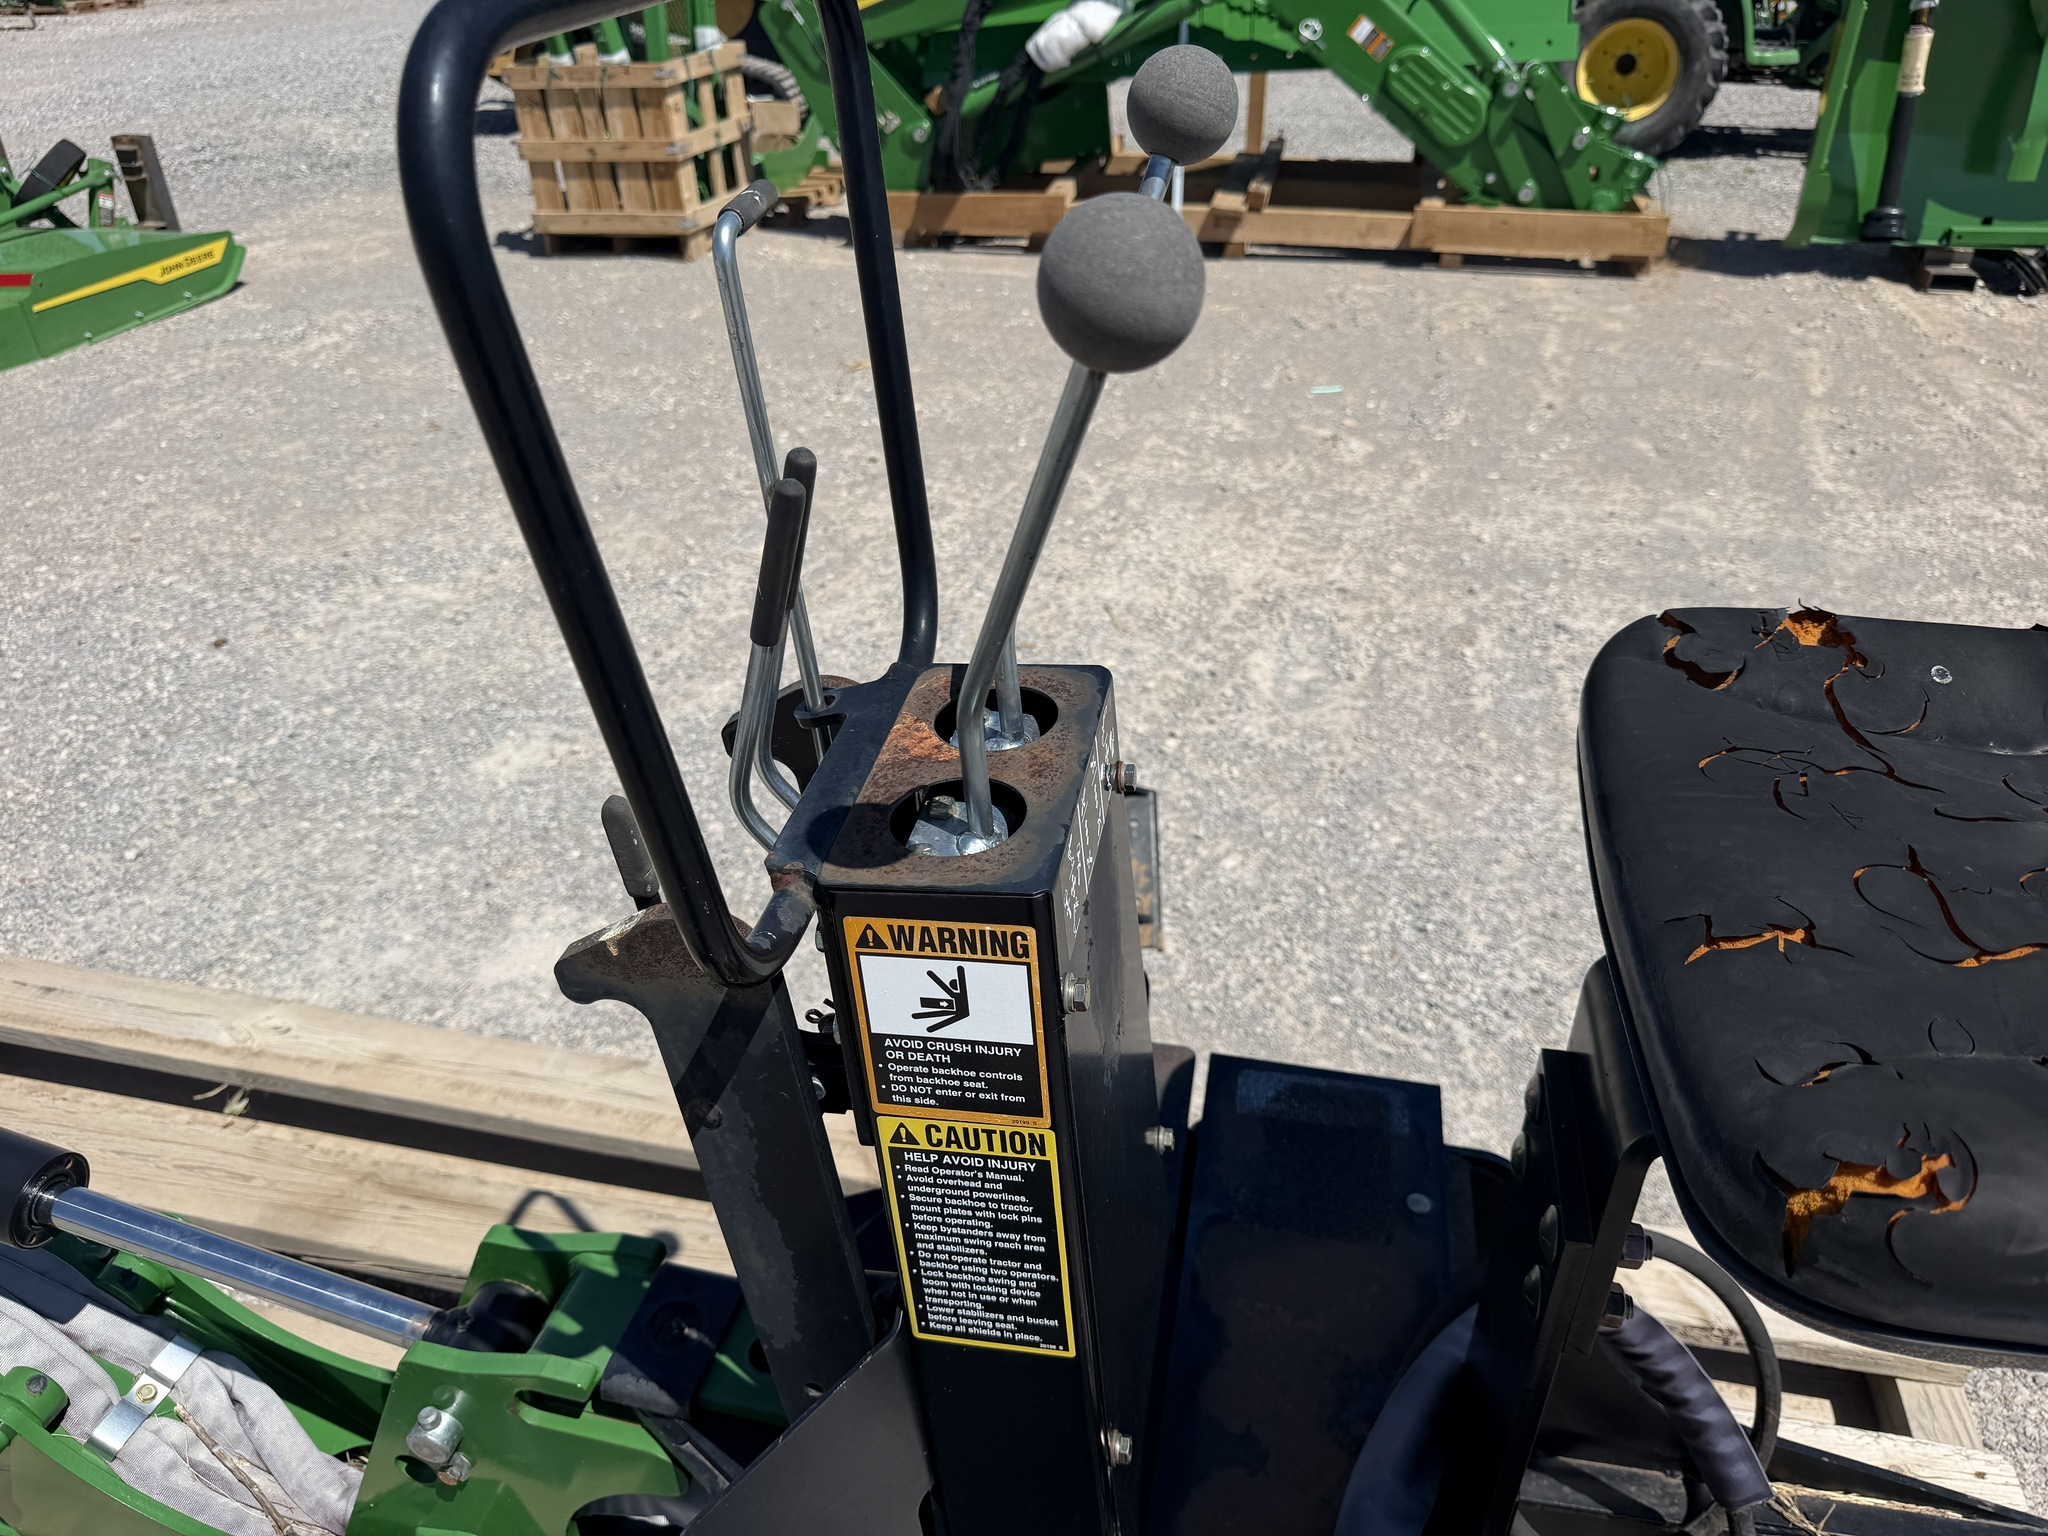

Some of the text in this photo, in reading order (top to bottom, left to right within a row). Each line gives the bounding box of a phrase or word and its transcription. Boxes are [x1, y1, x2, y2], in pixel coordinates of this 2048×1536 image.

[159, 250, 215, 277] JOHN DEERE
[887, 924, 1030, 959] WARNING
[884, 1038, 1022, 1057] AVOID CRUSH INJURY
[885, 1050, 951, 1064] OR DEATH
[887, 1062, 1023, 1081] Operate backhoe controls
[889, 1073, 988, 1089] from backhoe seat.
[891, 1083, 907, 1092] DO
[909, 1085, 933, 1095] NOT
[935, 1089, 963, 1097] enter
[978, 1092, 998, 1101] exit
[1000, 1093, 1026, 1103] from
[892, 1094, 939, 1106] this side.
[925, 1124, 1047, 1157] CAUTION
[904, 1151, 1036, 1172] HELP AVOID INJURY
[904, 1164, 1025, 1182] Read Operator's Manual.
[906, 1174, 1003, 1190] Avoid overhead and
[907, 1185, 1029, 1203] underground powerlines.
[908, 1193, 1034, 1212] Secure backhoe to tractor
[910, 1204, 1043, 1223] mount plates with lock pins
[911, 1212, 994, 1228] before operating.
[913, 1222, 1046, 1243] Keep bystanders away from
[915, 1233, 1045, 1252] maximum swing reach area
[916, 1242, 988, 1255] and stabilizers.
[918, 1250, 1042, 1270] Do not operate tractor and
[919, 1259, 1059, 1282] backhoe using two operators.
[920, 1268, 1037, 1288] Lock backhoe swing and
[922, 1277, 1041, 1298] boom with locking device
[923, 1287, 949, 1296] when
[950, 1290, 967, 1298] not
[968, 1291, 978, 1299] in
[979, 1294, 997, 1302] use
[1011, 1297, 1037, 1306] when
[924, 1295, 985, 1310] transporting.
[926, 1304, 1059, 1327] Lower stabilizers and bucket
[927, 1313, 1018, 1330] before leaving seat.
[929, 1321, 953, 1331] Keep
[968, 1327, 1002, 1337] shields
[1003, 1330, 1013, 1338] in
[1014, 1332, 1043, 1342] place.
